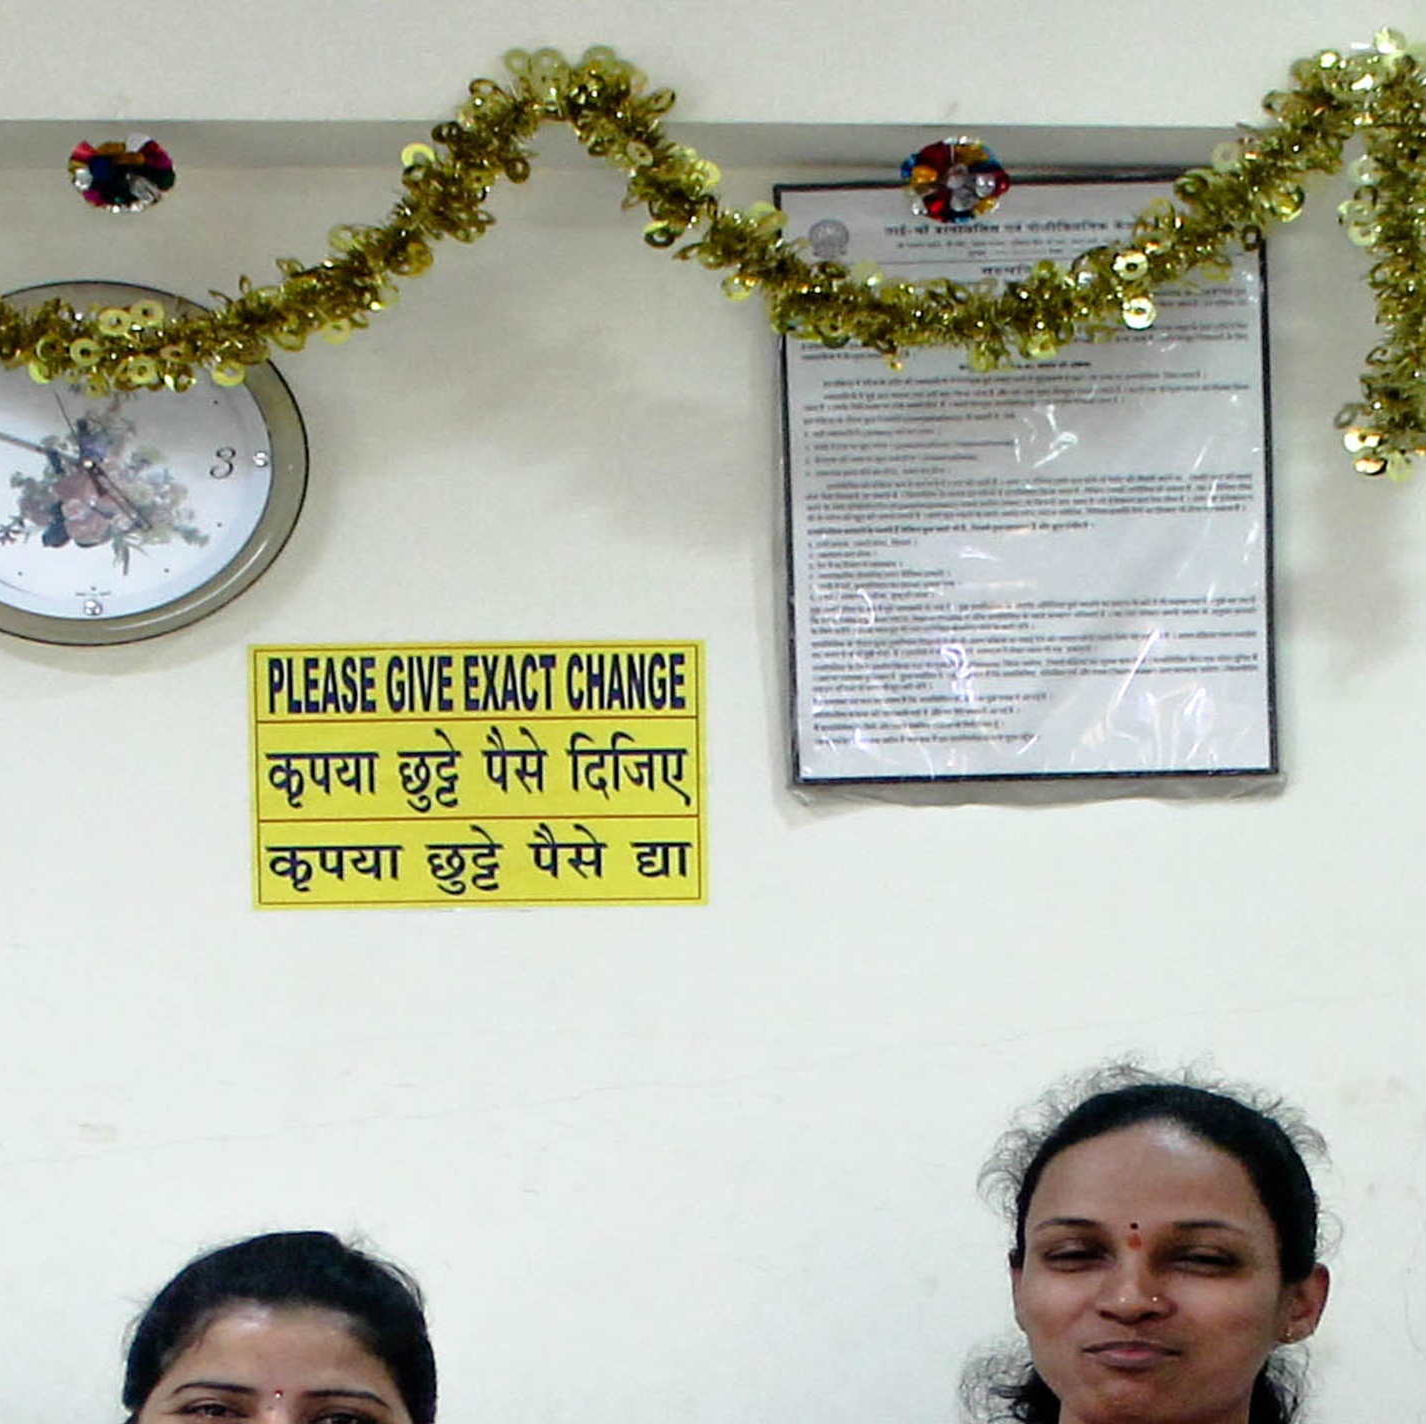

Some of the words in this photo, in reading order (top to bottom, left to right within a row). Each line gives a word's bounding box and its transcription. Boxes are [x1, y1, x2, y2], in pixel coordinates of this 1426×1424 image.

[209, 446, 237, 479] 3
[269, 657, 376, 714] PLEASE
[386, 655, 454, 712] GIVE
[464, 654, 556, 711] EXACT
[567, 653, 685, 711] CHANGE
[265, 752, 380, 808] कृपया
[397, 727, 462, 813] छुट्टे
[482, 726, 548, 793] पैसे
[565, 732, 691, 806] दिजिए
[265, 845, 405, 892] कृपया
[425, 825, 503, 895] छुट्टे
[527, 823, 608, 879] पैसे
[631, 842, 693, 878] द्या
